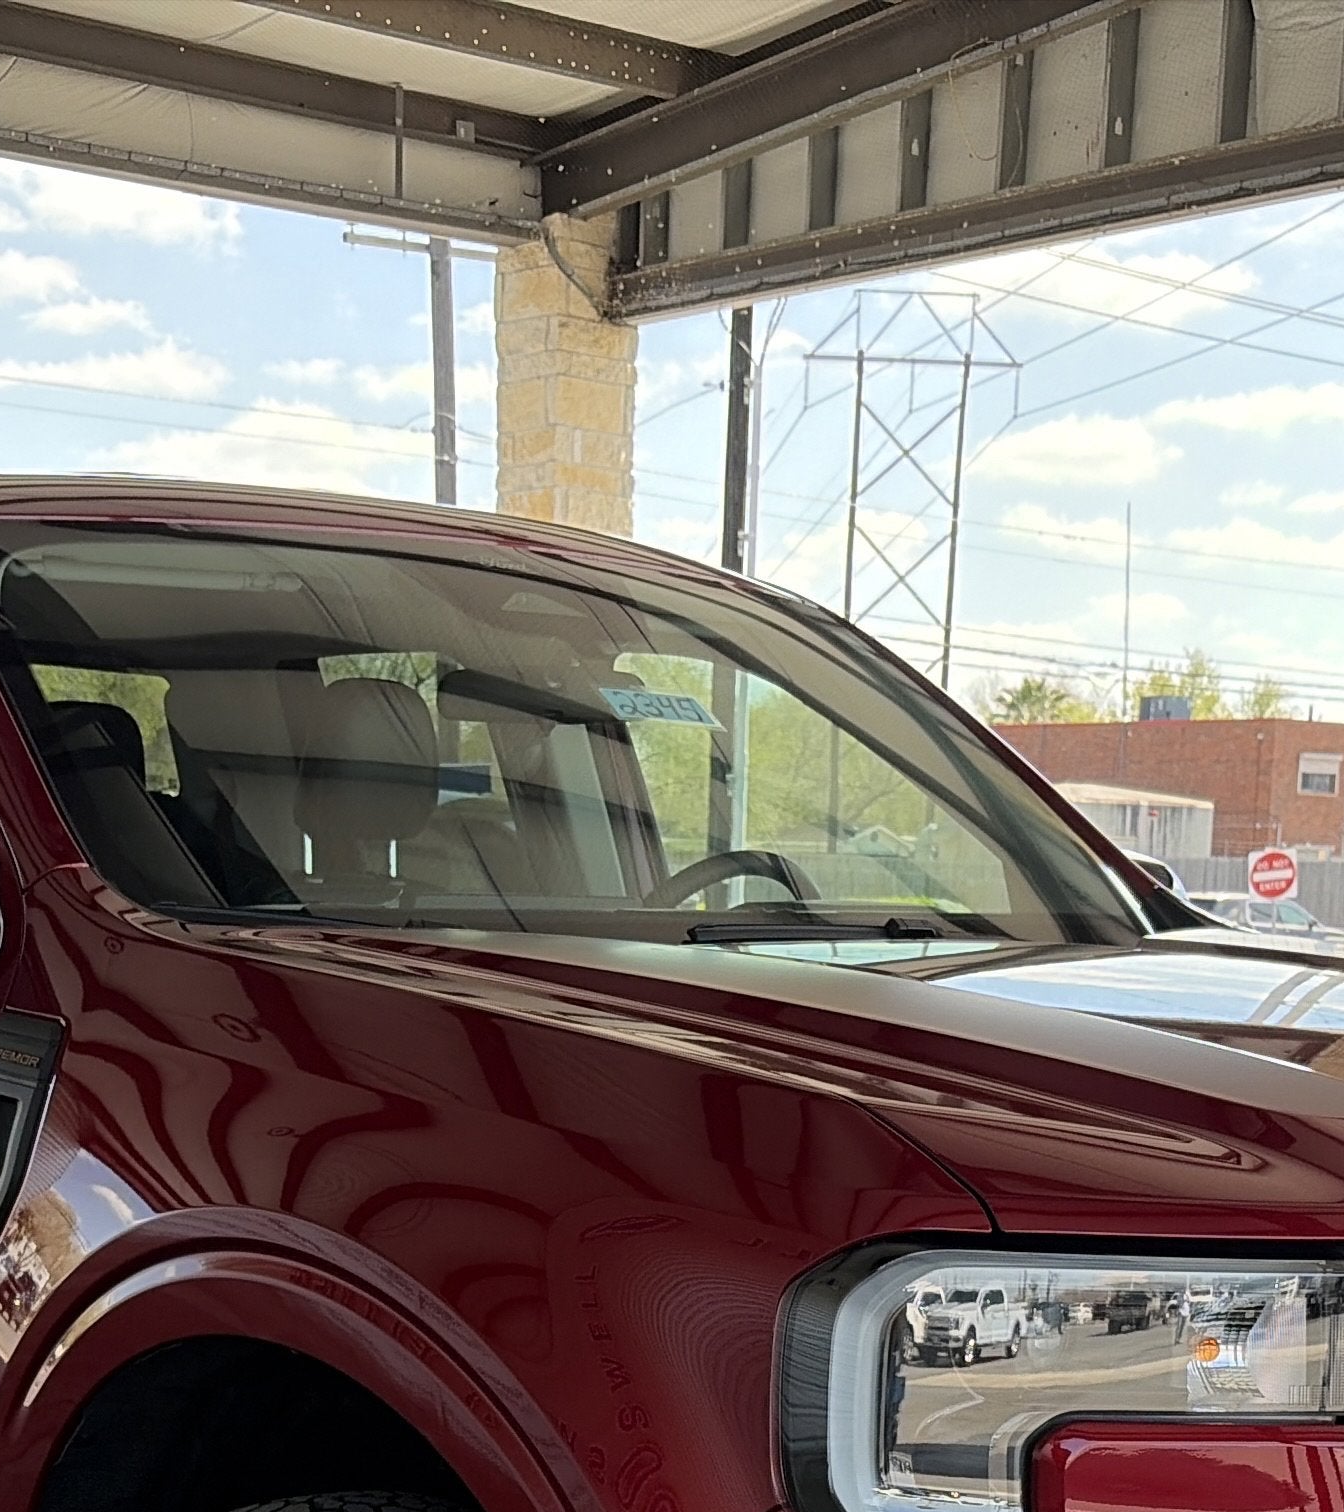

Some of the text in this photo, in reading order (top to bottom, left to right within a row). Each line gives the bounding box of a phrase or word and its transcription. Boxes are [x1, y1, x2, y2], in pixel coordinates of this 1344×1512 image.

[612, 690, 704, 722] 2345
[1256, 859, 1290, 870] DO NOT
[1259, 881, 1287, 892] ENTER
